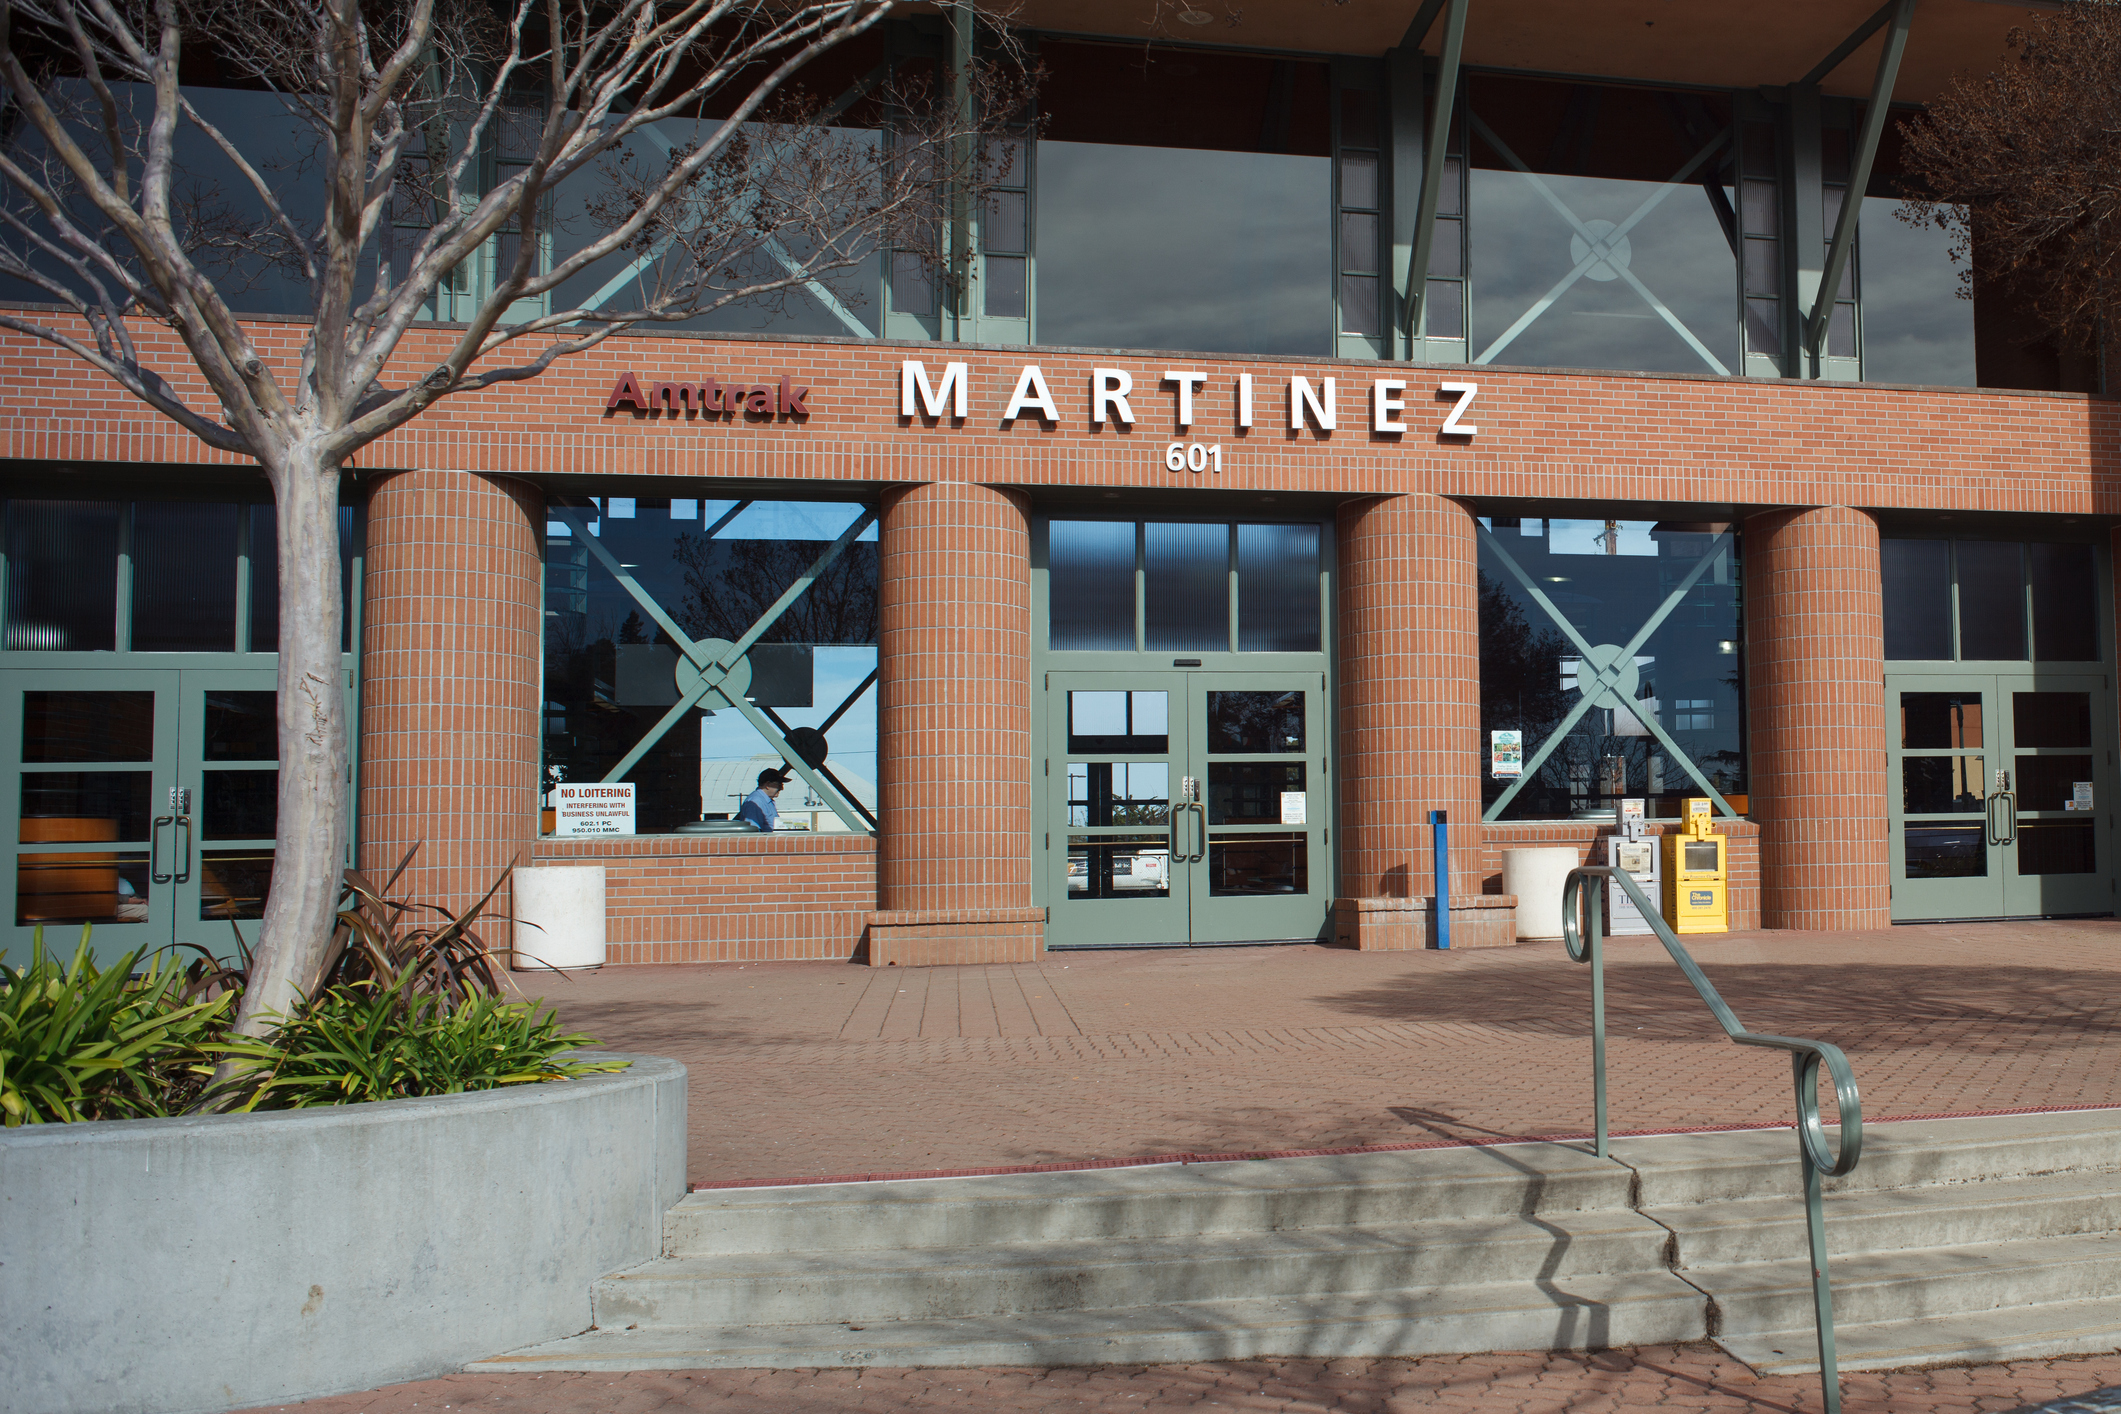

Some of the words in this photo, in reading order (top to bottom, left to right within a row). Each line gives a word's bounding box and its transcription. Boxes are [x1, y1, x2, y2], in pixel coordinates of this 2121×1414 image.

[606, 371, 810, 414] Amtrak
[902, 360, 1478, 435] MARTINEZ
[1166, 442, 1222, 472] 601
[561, 788, 575, 798] NO
[579, 788, 631, 797] LOITERING
[1618, 894, 1652, 904] TIS
